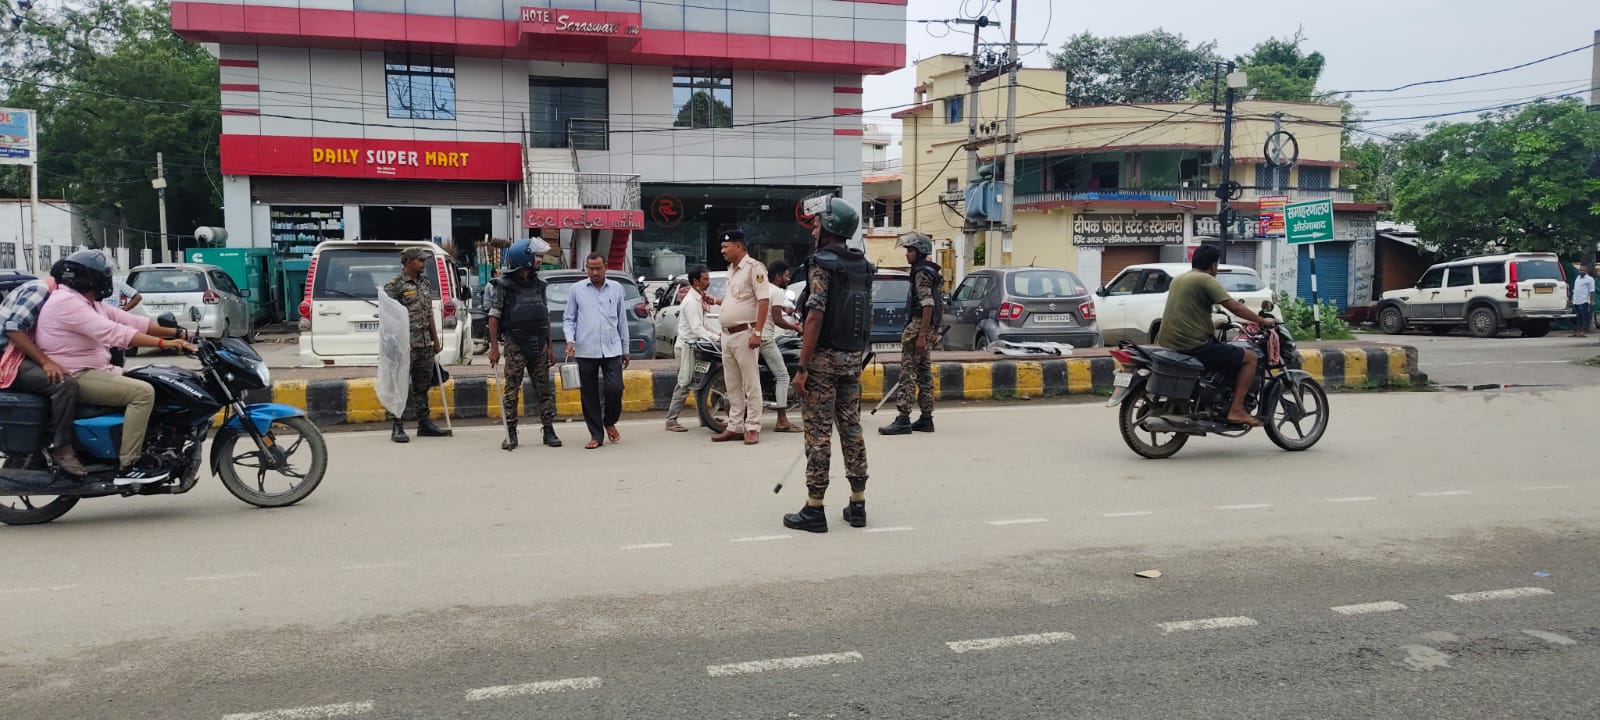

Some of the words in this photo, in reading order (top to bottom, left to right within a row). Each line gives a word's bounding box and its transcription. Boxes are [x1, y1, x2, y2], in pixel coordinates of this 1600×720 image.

[312, 148, 359, 165] DAILY
[366, 150, 419, 167] SUPER
[425, 151, 469, 168] MART
[528, 211, 557, 227] ice
[1287, 202, 1330, 219] समाहरणालय
[1073, 215, 1100, 234] दीपक
[1102, 215, 1123, 234] फोटो
[1125, 215, 1143, 234] स्टेट
[1149, 214, 1183, 234] स्टेशनरी
